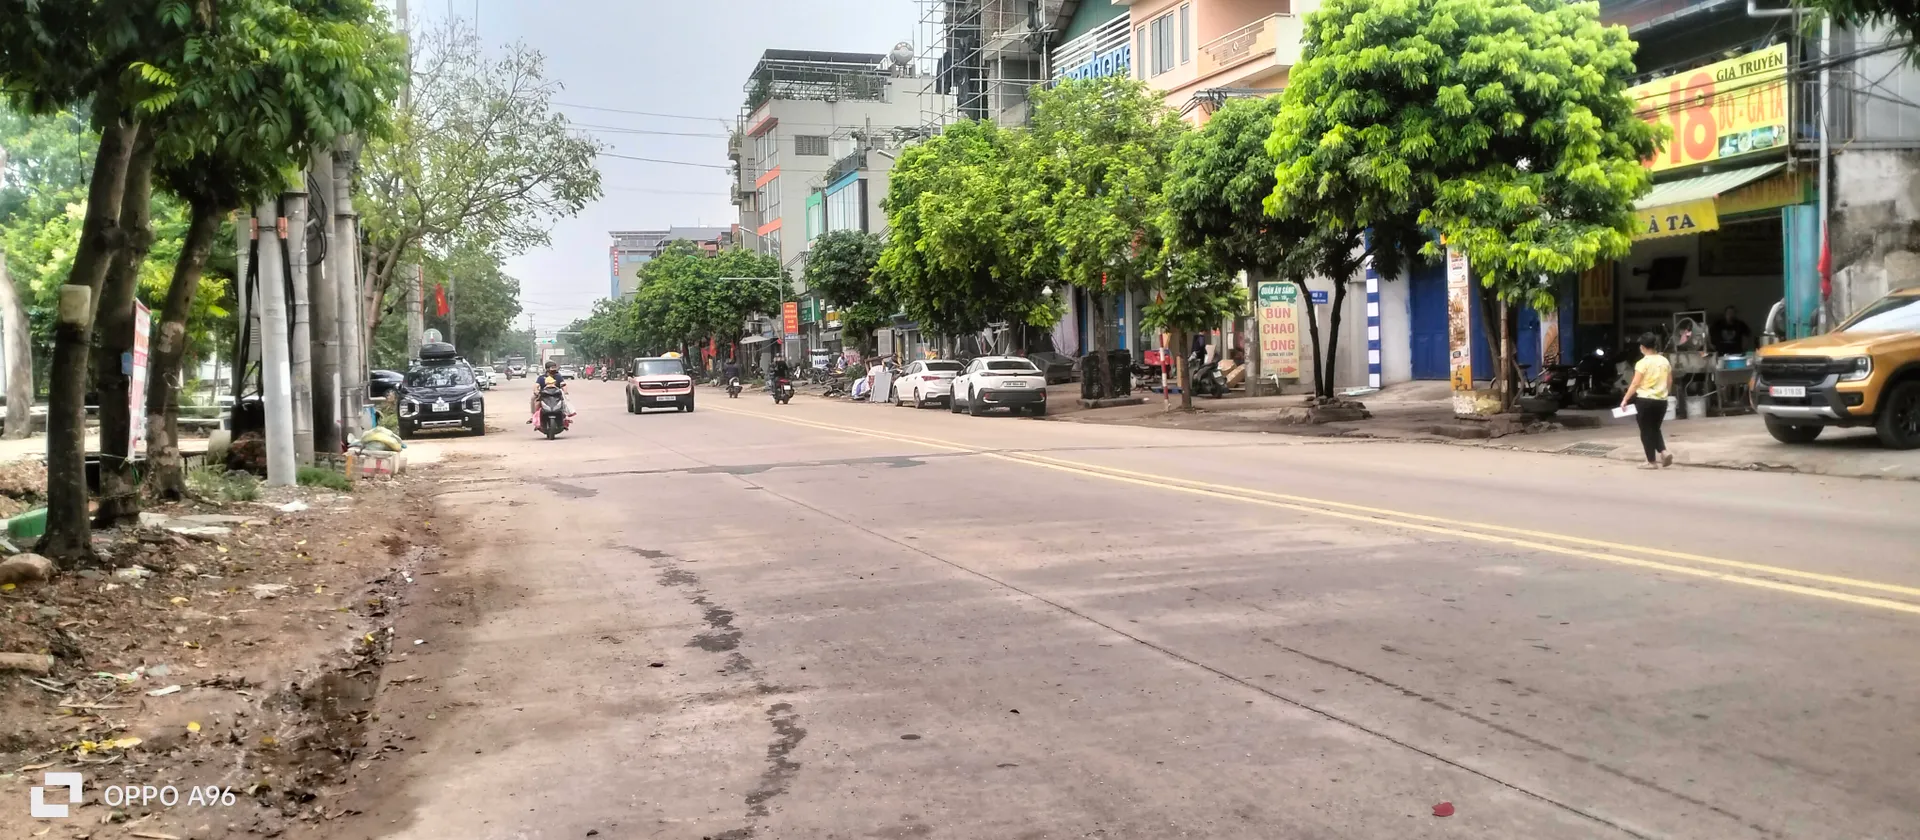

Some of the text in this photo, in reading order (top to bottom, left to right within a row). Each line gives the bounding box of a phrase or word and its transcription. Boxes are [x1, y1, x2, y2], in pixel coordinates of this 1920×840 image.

[1716, 66, 1736, 81] GIA
[1669, 72, 1717, 164] 18
[1666, 213, 1696, 230] TA
